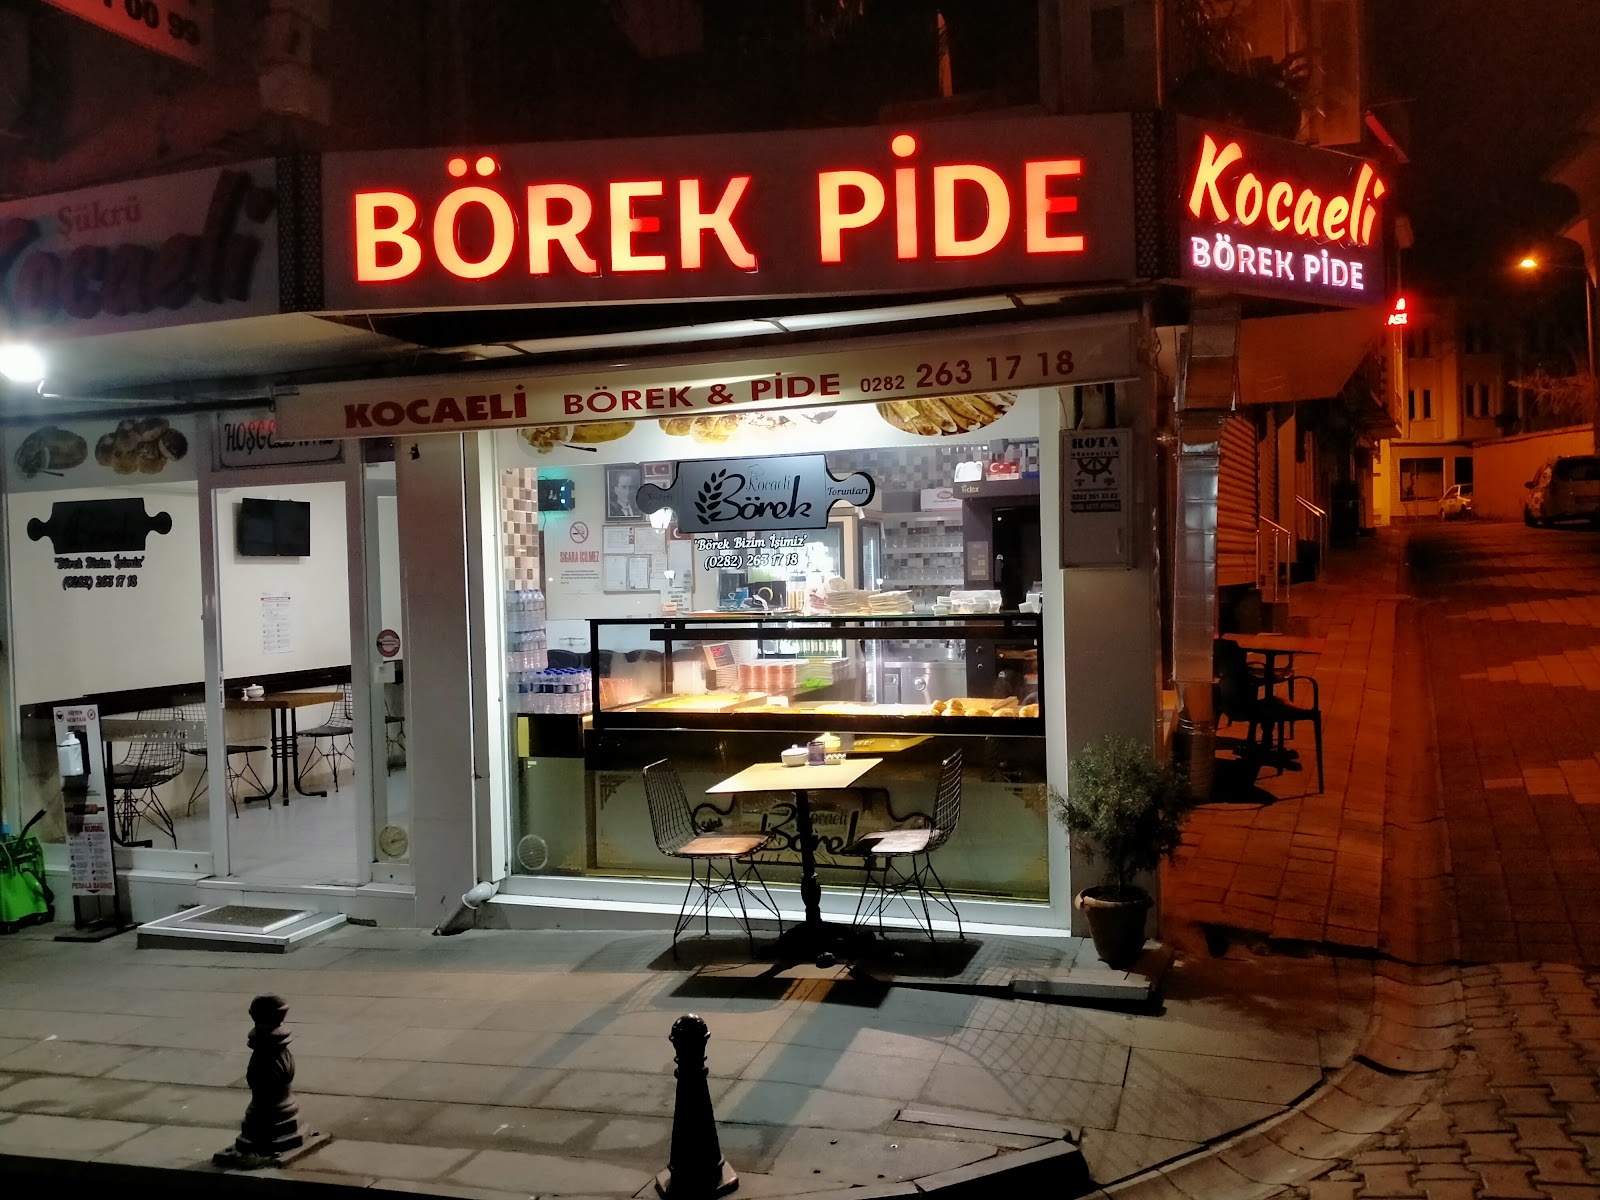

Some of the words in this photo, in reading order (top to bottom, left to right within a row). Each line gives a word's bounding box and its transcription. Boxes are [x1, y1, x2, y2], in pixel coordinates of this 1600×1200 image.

[1188, 133, 1386, 246] Kocaeli
[353, 155, 757, 283] BÖREK
[818, 134, 1085, 263] PİDE
[1190, 232, 1295, 281] BÖREK
[1303, 248, 1365, 290] PİDE
[344, 384, 528, 429] KOCAELİ
[563, 386, 693, 415] BÖREK
[707, 383, 734, 405] &
[750, 371, 840, 401] PİDE
[860, 375, 906, 393] 0282
[916, 360, 972, 389] 263
[986, 355, 1022, 382] 17
[1037, 350, 1075, 376] 18
[1071, 436, 1119, 450] ROTA
[745, 475, 791, 492] Kocaeli
[826, 486, 869, 497] Torunları
[709, 473, 813, 522] Börek
[733, 536, 766, 549] Bizim
[703, 553, 743, 571] (0282)
[746, 552, 769, 568] 263
[770, 552, 785, 567] 17
[785, 551, 799, 566] 18
[808, 809, 848, 826] ocaeli
